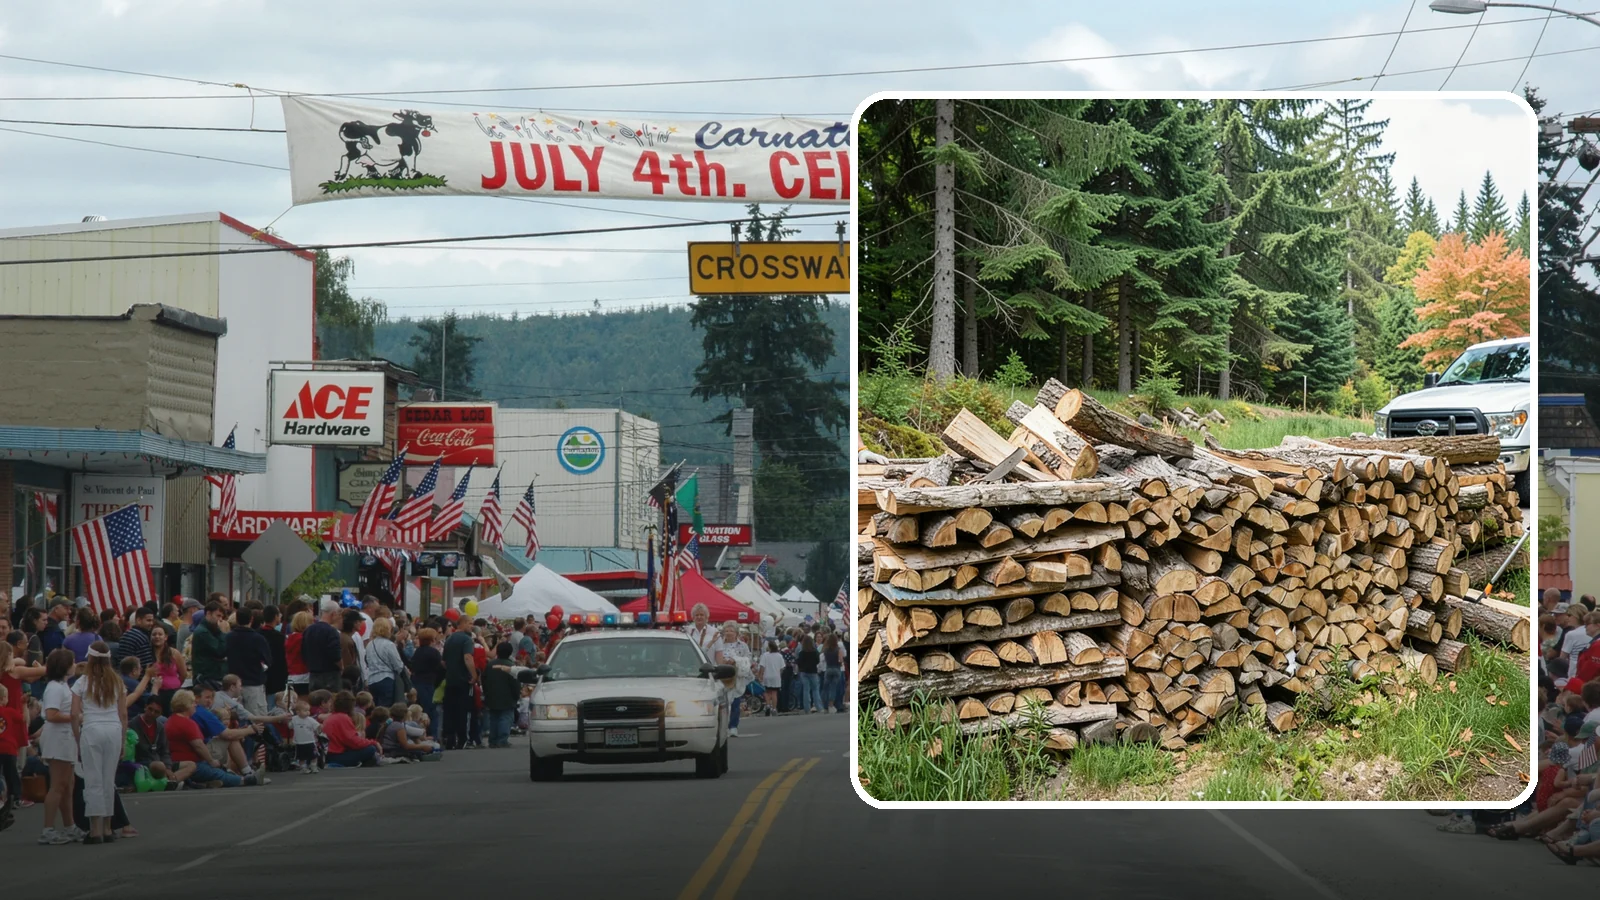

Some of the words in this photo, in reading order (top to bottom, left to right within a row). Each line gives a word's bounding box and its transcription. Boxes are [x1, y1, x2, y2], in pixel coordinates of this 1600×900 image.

[481, 141, 605, 193] JULY
[632, 150, 747, 198] 4th.
[696, 254, 850, 280] CROSSWA
[282, 380, 373, 420] ACE
[405, 409, 453, 422] CEDAR
[283, 420, 371, 437] Hardware
[416, 428, 477, 447] Coca-Cola
[353, 467, 385, 480] Simpl
[83, 485, 94, 494] St.
[95, 485, 125, 494] Vincent
[126, 485, 135, 495] de
[137, 486, 155, 495] Paul
[81, 503, 154, 522] THT
[212, 515, 331, 536] HARDARE
[687, 526, 741, 535] CRNATION
[698, 535, 730, 543] GLASS
